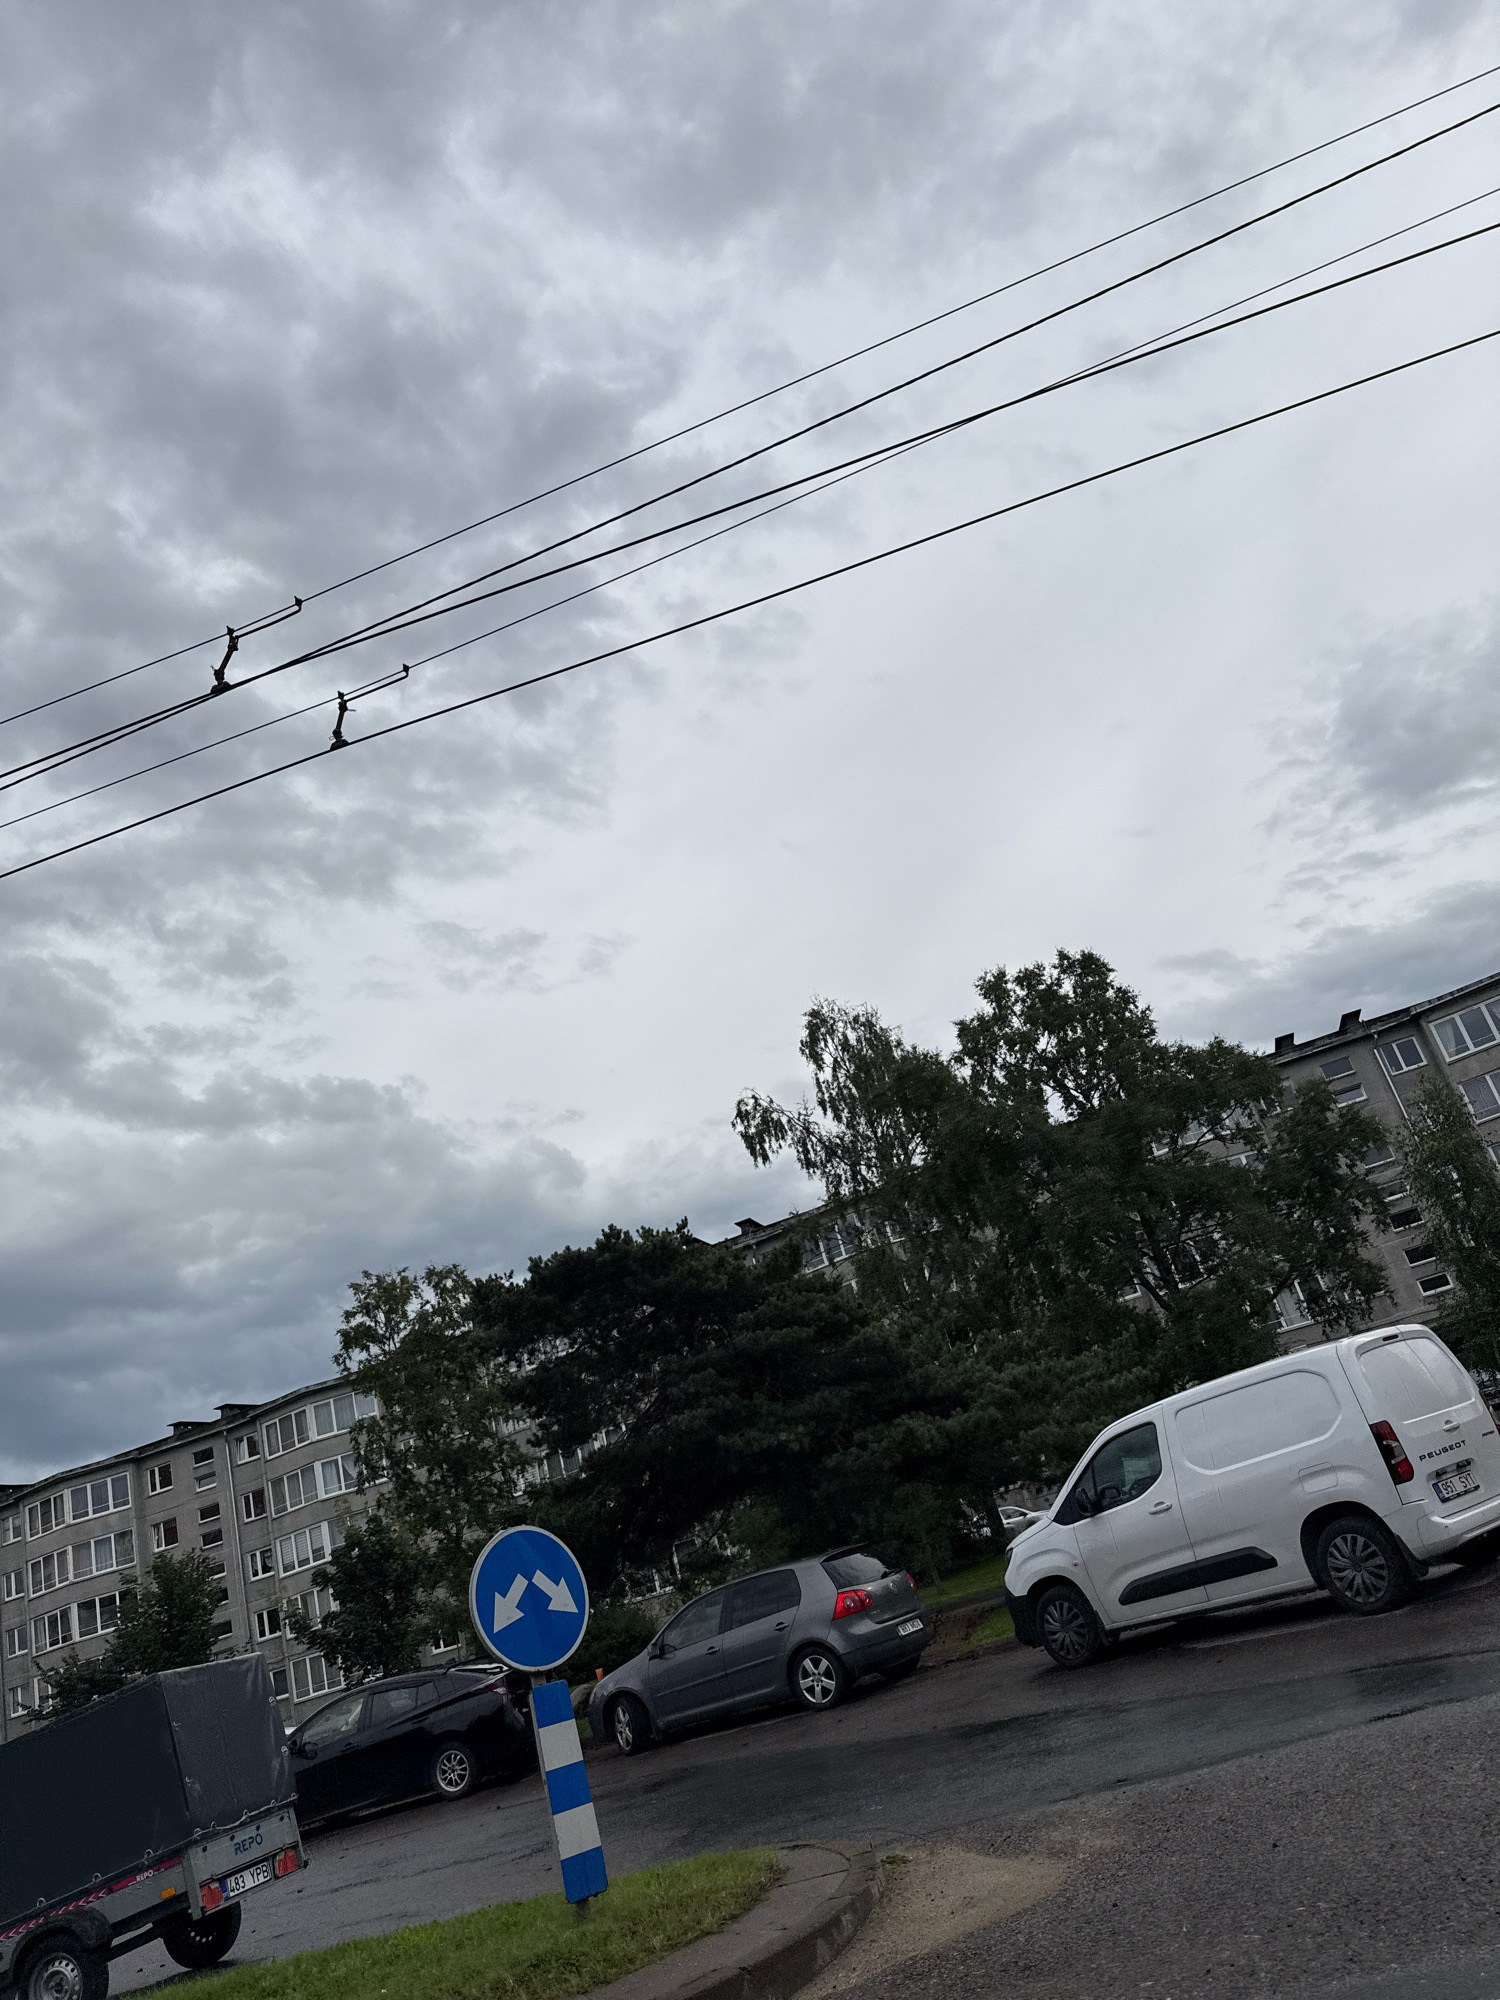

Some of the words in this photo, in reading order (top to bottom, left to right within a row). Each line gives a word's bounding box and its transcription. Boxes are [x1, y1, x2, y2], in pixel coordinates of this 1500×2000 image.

[1419, 1440, 1466, 1461] PEUGEOT
[1441, 1480, 1457, 1495] 951
[1458, 1472, 1475, 1489] SYT
[234, 1833, 263, 1856] REPO
[136, 1870, 154, 1882] REPO
[229, 1875, 246, 1893] 483
[249, 1864, 269, 1884] YPB
